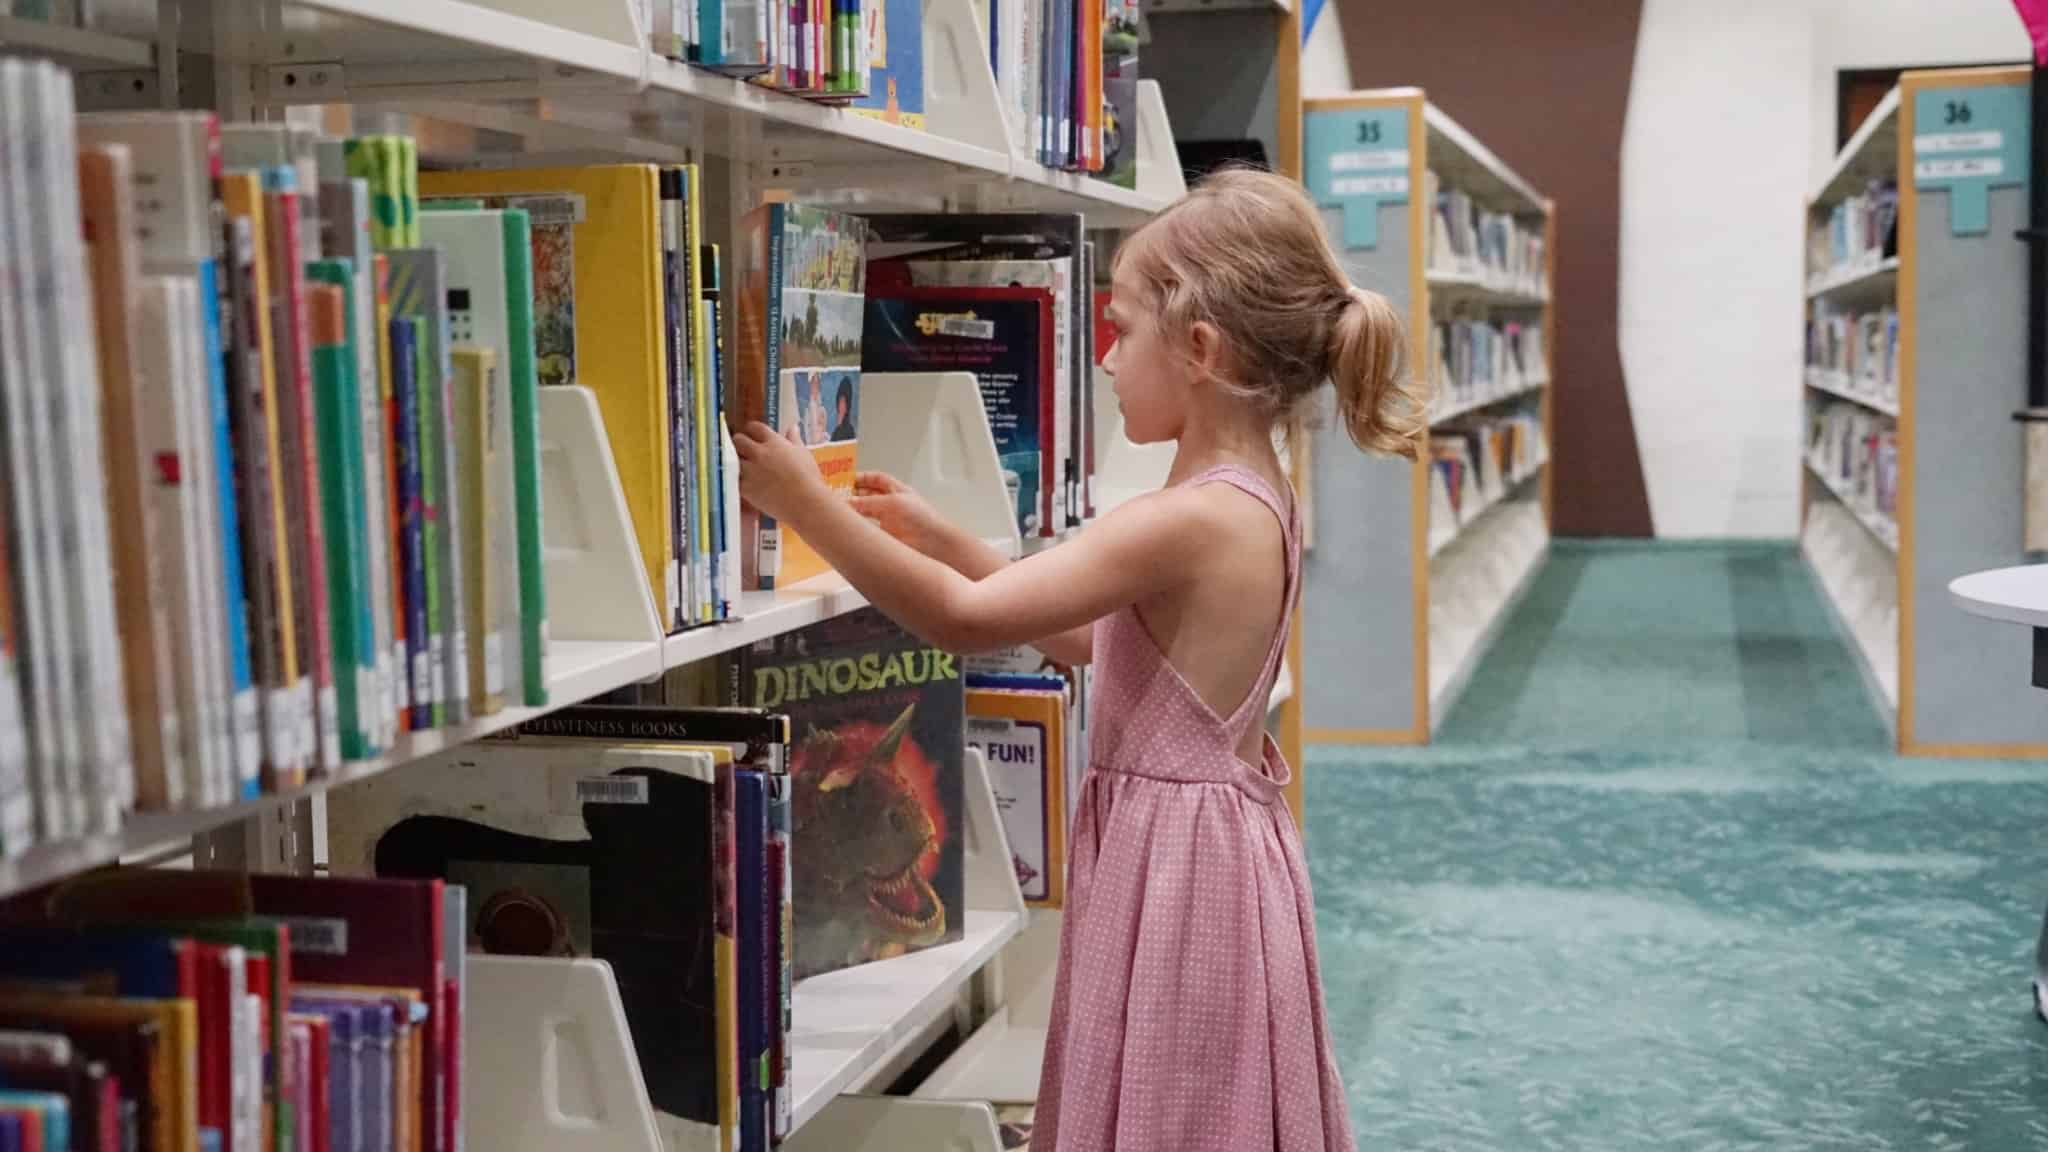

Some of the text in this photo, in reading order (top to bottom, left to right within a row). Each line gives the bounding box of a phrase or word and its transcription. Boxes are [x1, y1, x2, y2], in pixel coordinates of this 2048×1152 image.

[1944, 101, 1972, 125] 36
[1356, 120, 1380, 144] 35
[753, 648, 959, 708] DINOSAUR
[524, 718, 688, 737] EYEWITNESS BOOKS
[987, 743, 1035, 764] FUN!
